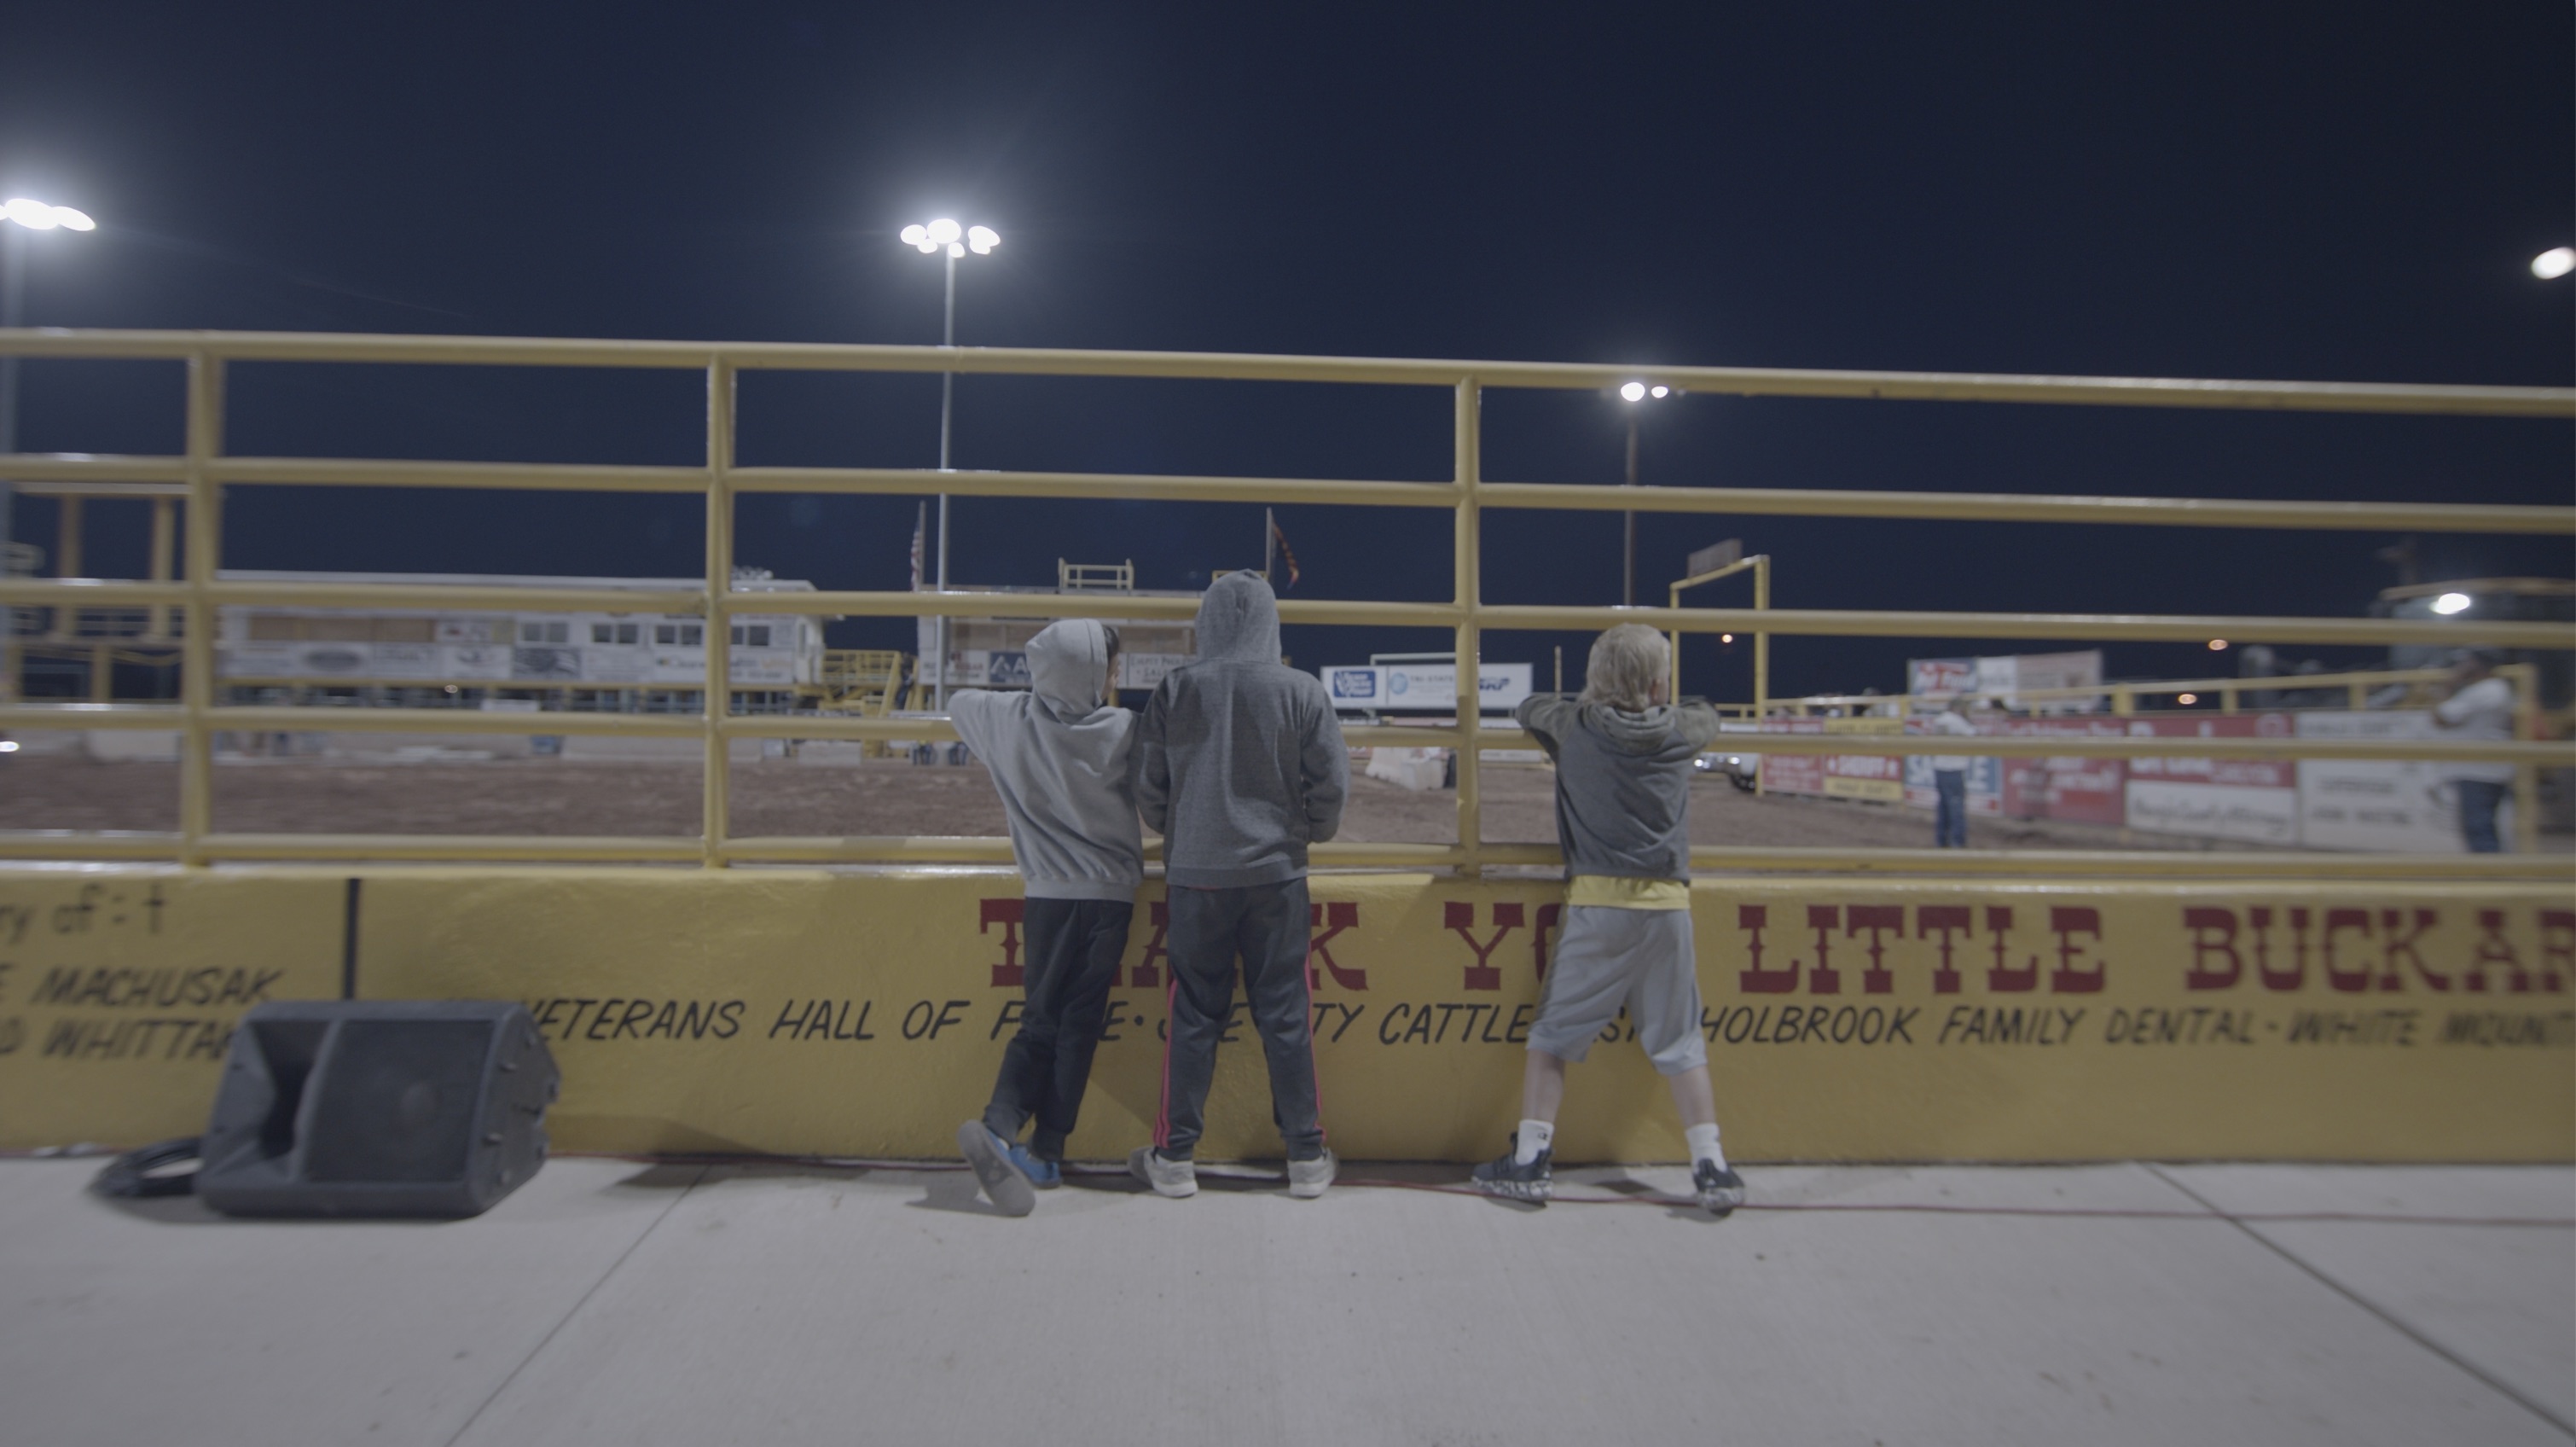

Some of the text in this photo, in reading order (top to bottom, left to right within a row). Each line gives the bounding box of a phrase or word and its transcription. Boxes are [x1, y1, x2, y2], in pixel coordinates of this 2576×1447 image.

[1738, 904, 2108, 995] LITTLE
[29, 967, 286, 1007] MACHUSAK
[769, 999, 874, 1041] HALL
[902, 1000, 971, 1040] OF
[1378, 1002, 1534, 1045] CATTLE
[1701, 1005, 1921, 1044] HOLBROOK
[1939, 1005, 2087, 1045] FAMILY
[2103, 1006, 2255, 1046] DENTAL
[2287, 1008, 2422, 1047] WHITE
